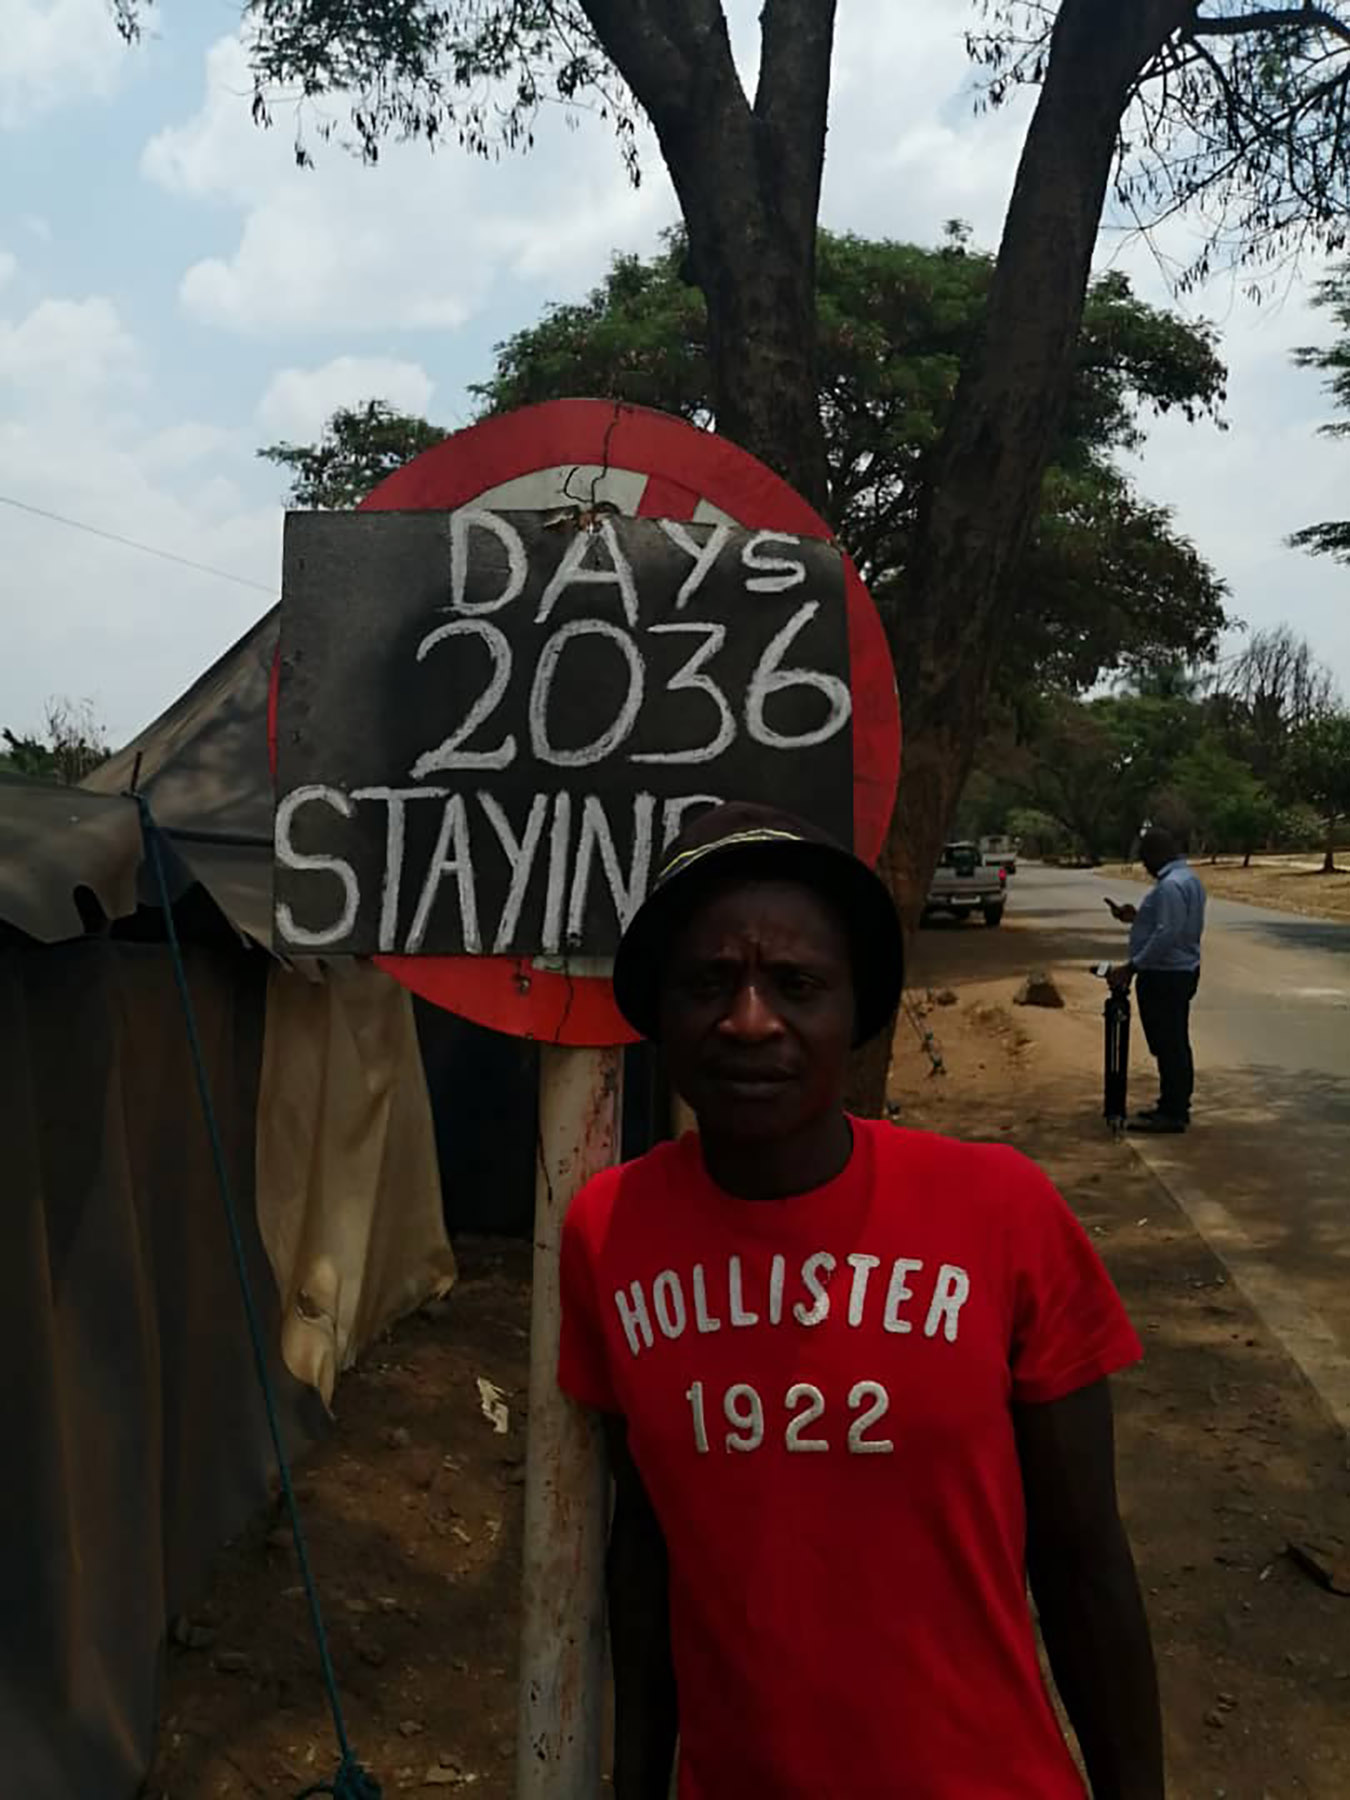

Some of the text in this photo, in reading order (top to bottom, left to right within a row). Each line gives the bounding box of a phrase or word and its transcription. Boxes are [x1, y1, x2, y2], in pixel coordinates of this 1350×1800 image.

[409, 600, 853, 780] 2036
[274, 784, 725, 954] STAYIN
[614, 1251, 971, 1356] HOLLISTER
[685, 1380, 894, 1454] 1922
